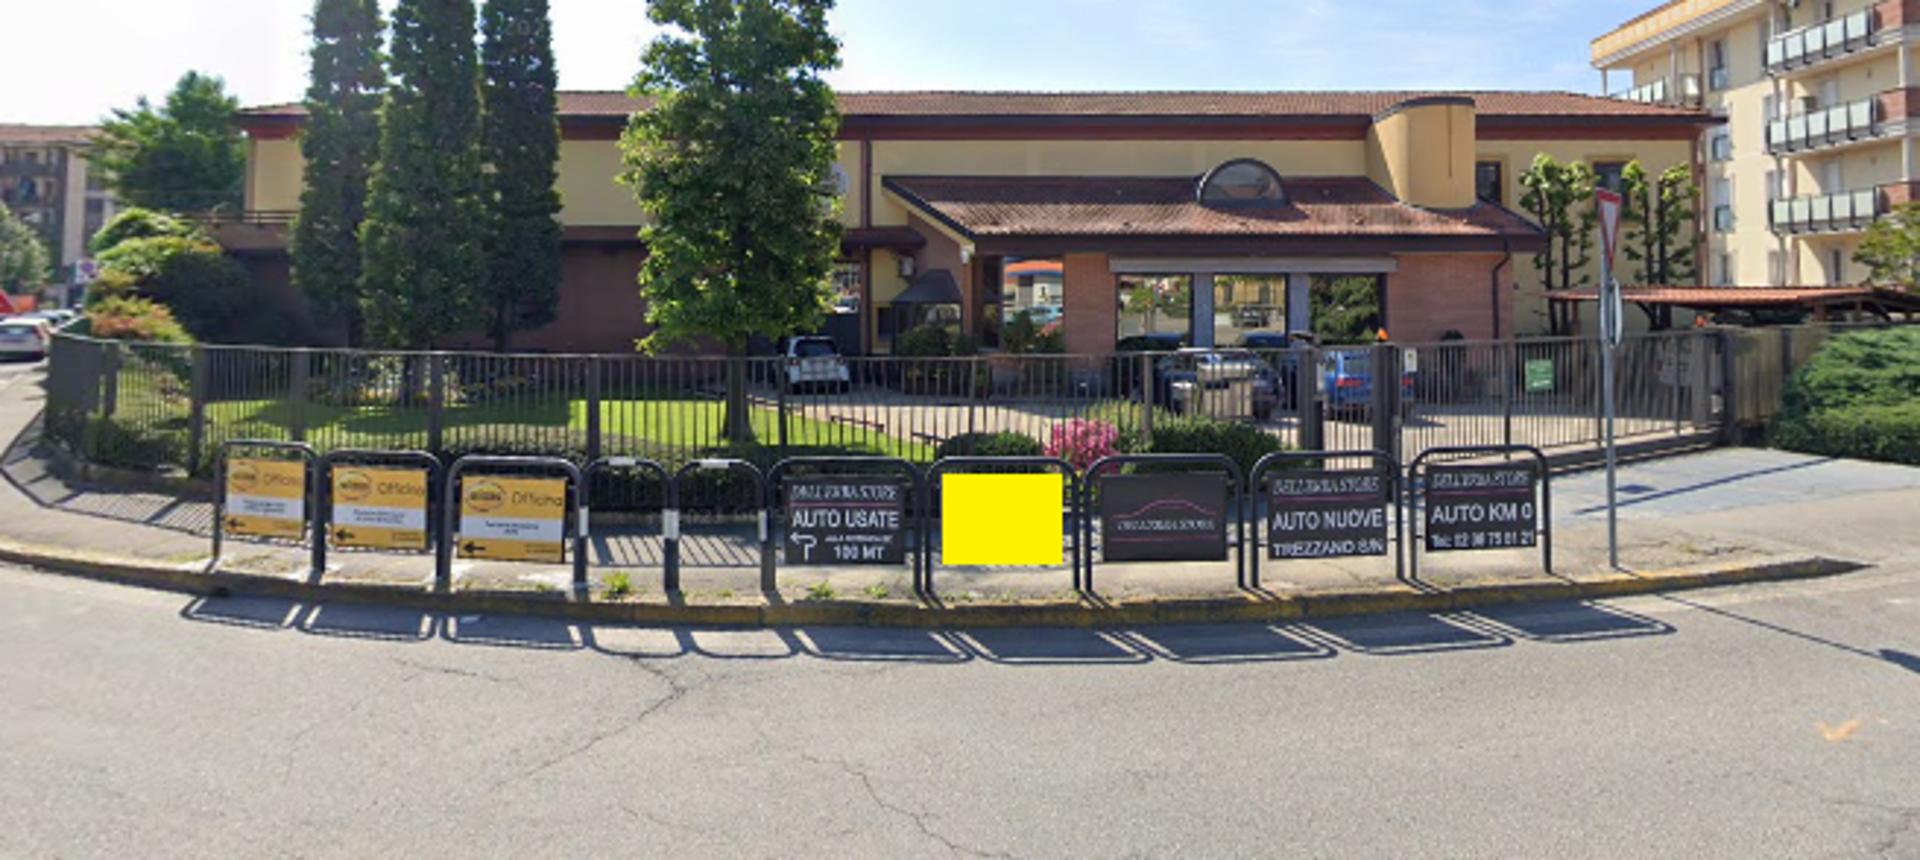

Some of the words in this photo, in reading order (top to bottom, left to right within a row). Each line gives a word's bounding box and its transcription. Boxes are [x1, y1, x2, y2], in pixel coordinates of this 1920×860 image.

[512, 490, 563, 507] Officina
[793, 510, 840, 528] AUTO
[845, 510, 899, 528] USATE
[1273, 511, 1320, 530] AUTO
[1324, 508, 1383, 529] NUOVE
[1431, 504, 1485, 524] AUTO
[1489, 503, 1517, 521] KM
[834, 545, 859, 560] 100
[863, 545, 884, 560] MT
